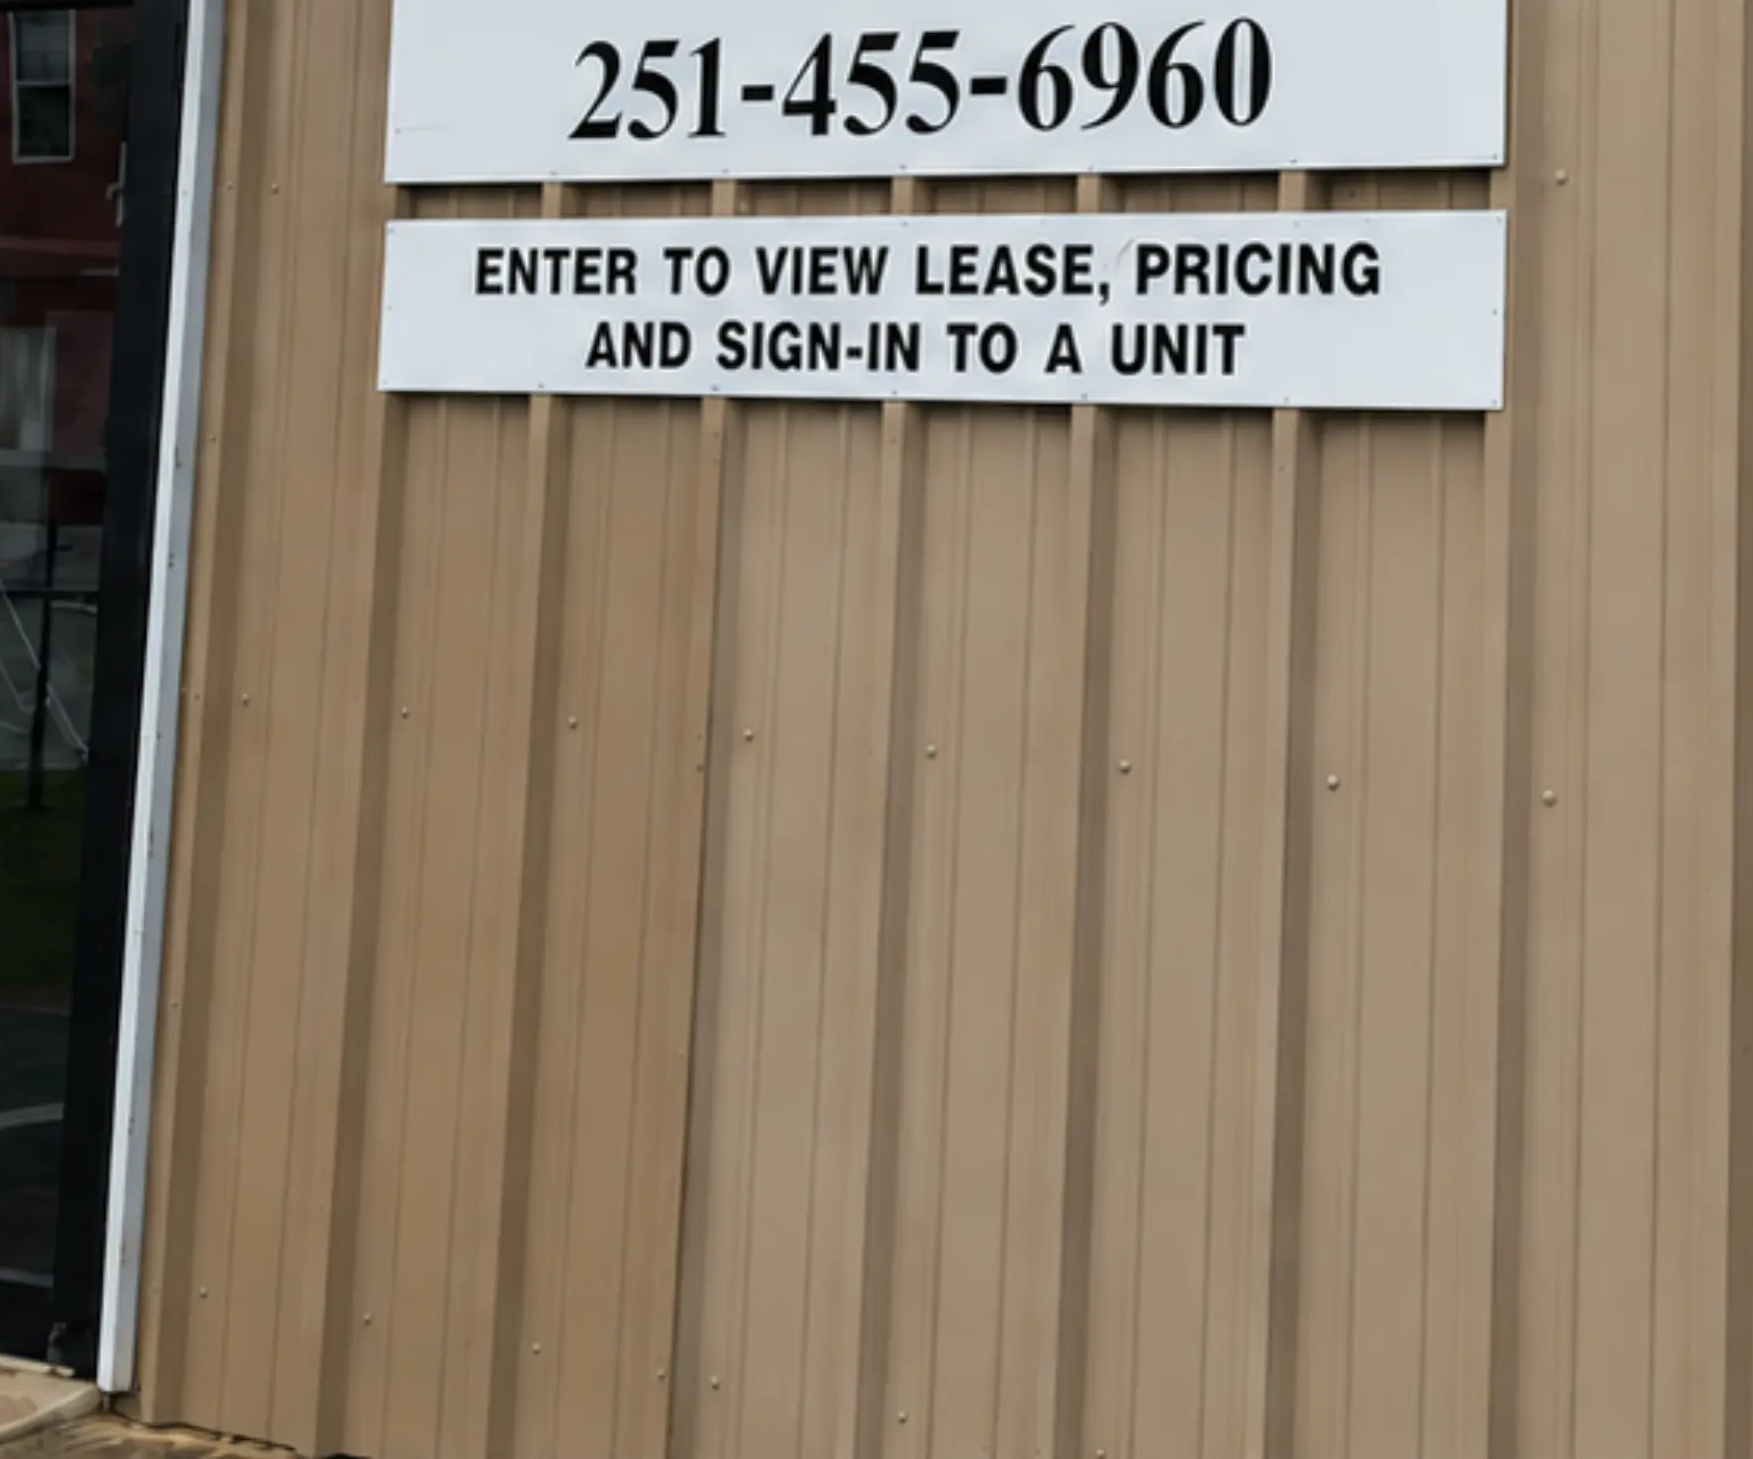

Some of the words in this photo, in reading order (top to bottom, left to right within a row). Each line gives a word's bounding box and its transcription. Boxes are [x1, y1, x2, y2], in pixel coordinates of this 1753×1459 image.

[568, 17, 1273, 140] 251-455-6960
[475, 247, 638, 296] ENTER
[662, 246, 730, 297] TO
[755, 245, 889, 296] VIEW
[915, 243, 1110, 305] LEASE,
[1136, 242, 1380, 297] PRICING
[585, 321, 692, 370] AND
[716, 320, 921, 373] SIGN-IN
[946, 322, 1018, 374] TO
[1044, 323, 1083, 375] A
[1111, 323, 1246, 376] UNIT
